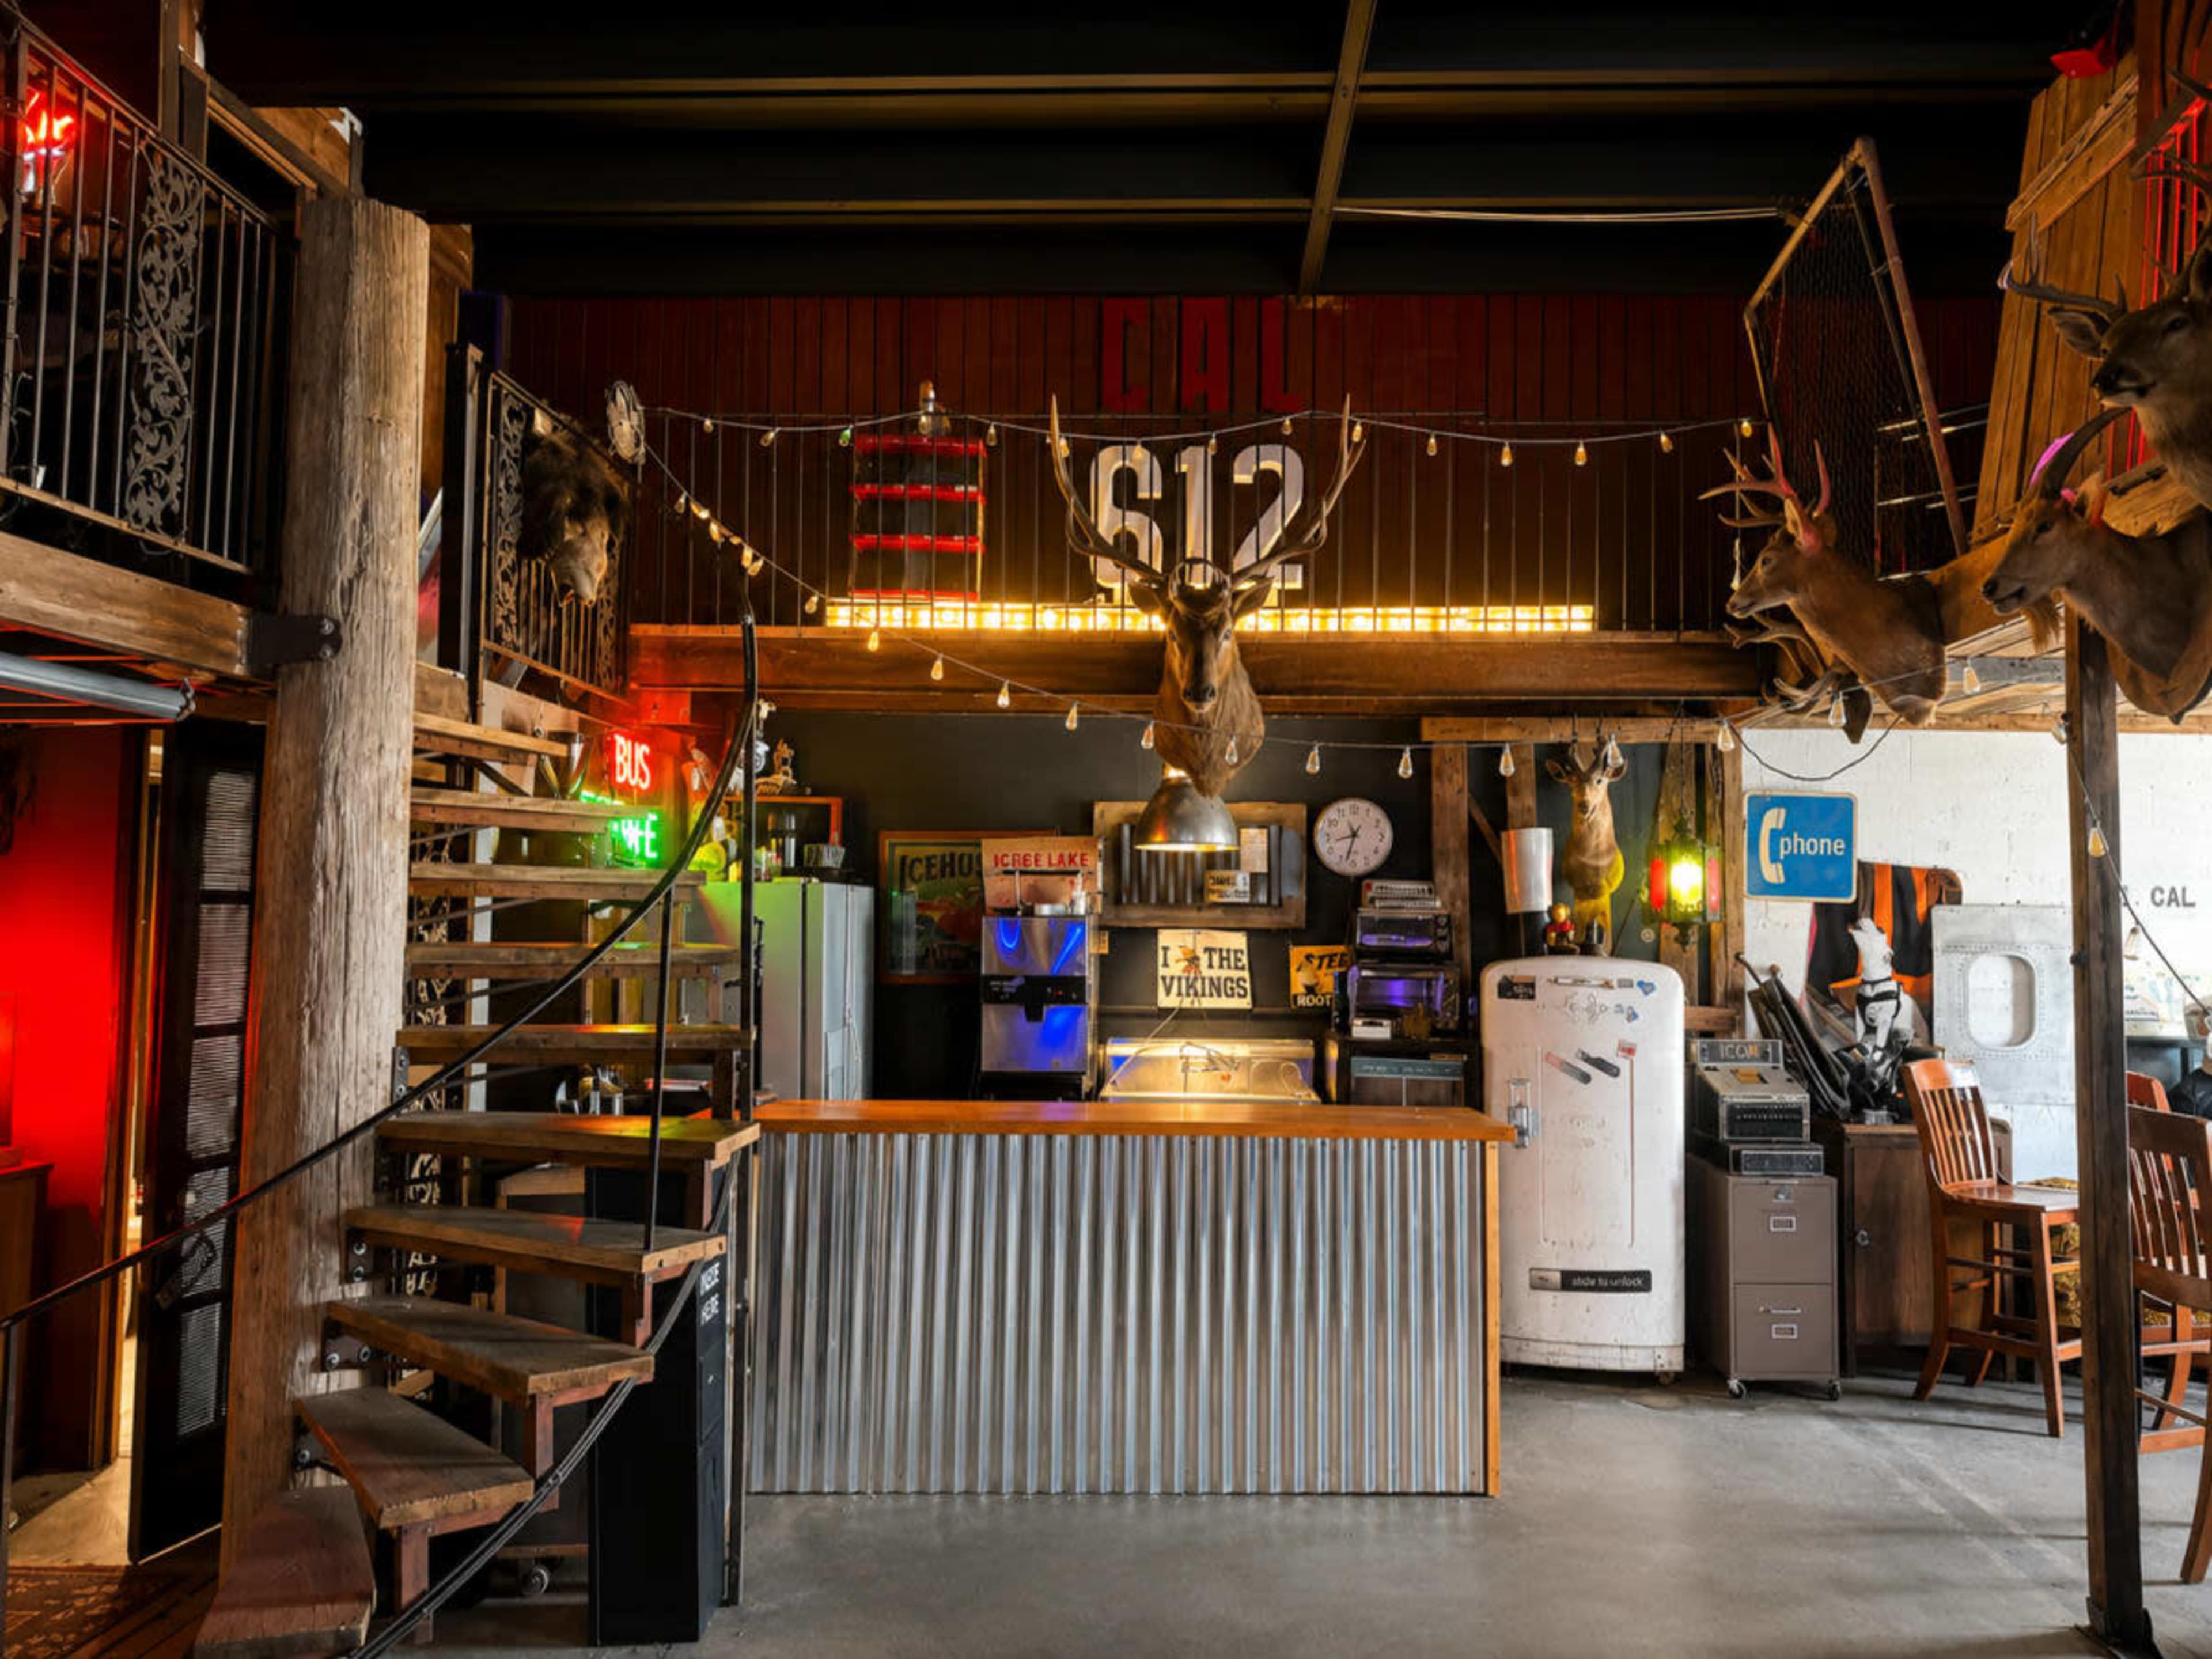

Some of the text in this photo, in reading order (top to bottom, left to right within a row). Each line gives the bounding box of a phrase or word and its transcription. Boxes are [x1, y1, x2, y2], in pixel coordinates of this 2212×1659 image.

[1102, 297, 1305, 413] CAL
[1090, 444, 1304, 589] 612
[614, 734, 650, 790] BUS
[1780, 832, 1846, 860] phone
[1047, 851, 1089, 868] LAKE
[2150, 885, 2196, 908] CAL
[1161, 946, 1245, 971] I THE
[1161, 975, 1248, 999] VIKINGS
[1297, 994, 1331, 1007] ROOT
